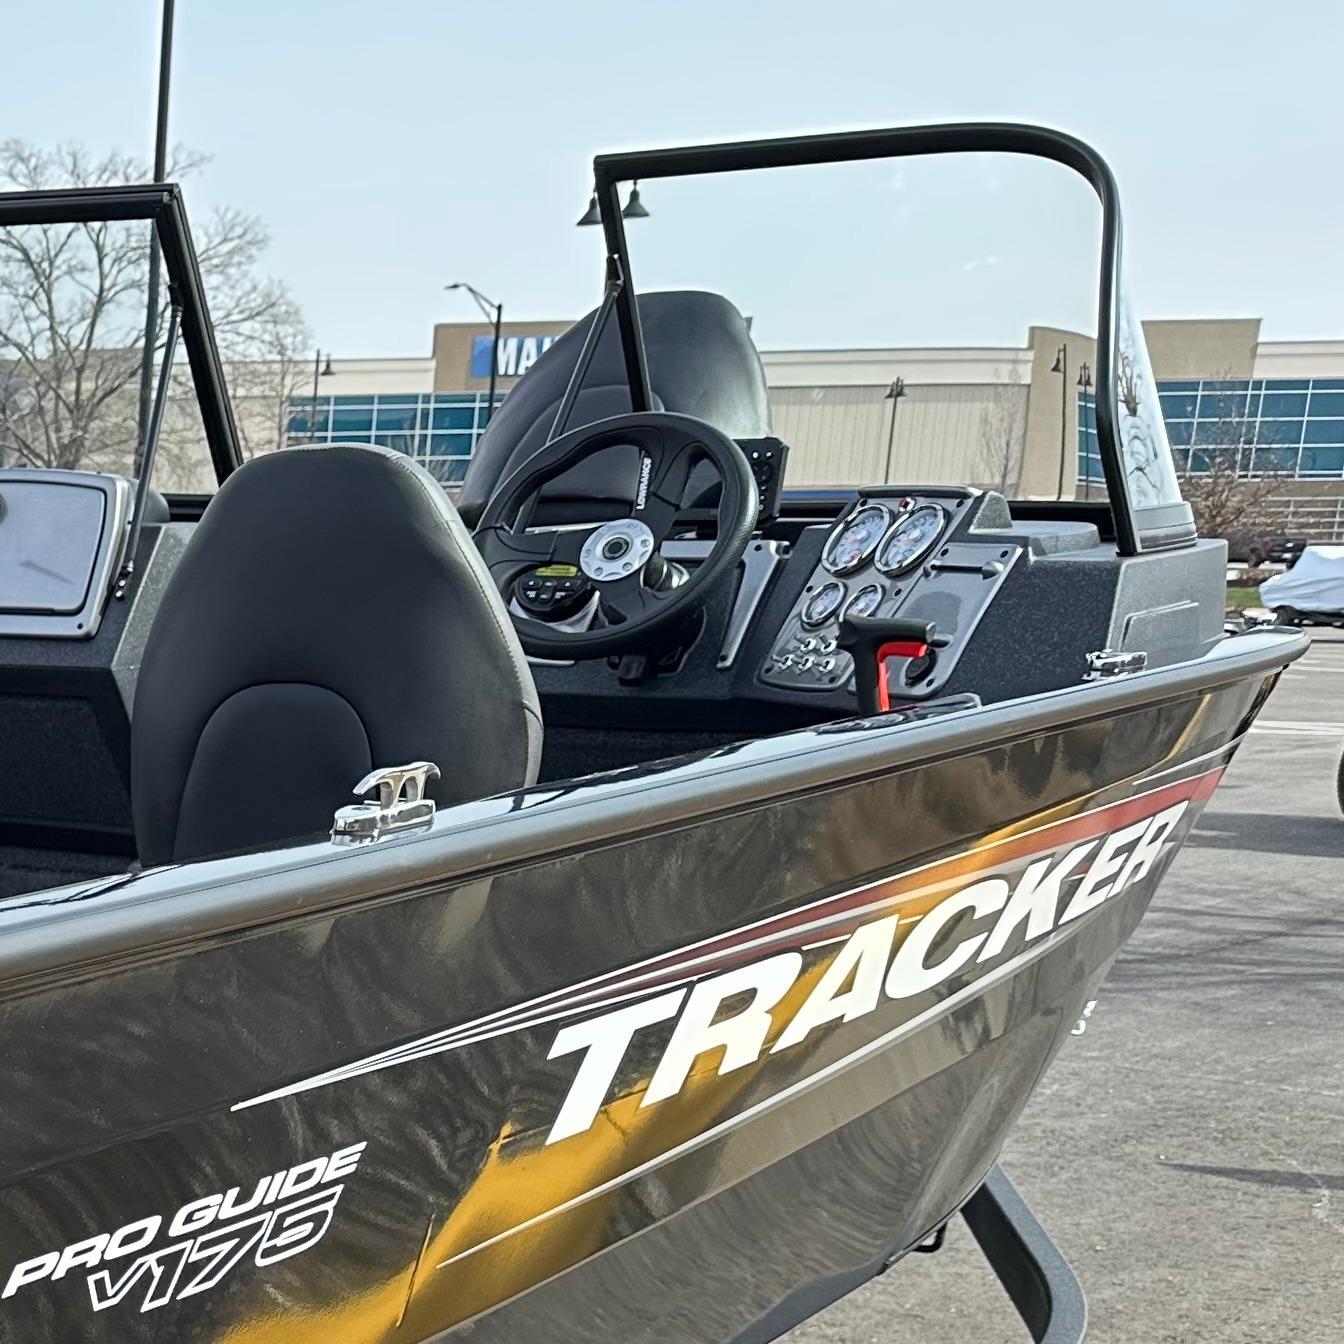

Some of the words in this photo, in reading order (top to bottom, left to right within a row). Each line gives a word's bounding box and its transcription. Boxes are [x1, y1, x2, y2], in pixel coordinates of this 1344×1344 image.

[545, 800, 1189, 1146] TRACKER
[1, 1214, 163, 1300] PRO
[168, 1140, 368, 1237] GUIDE
[86, 1183, 345, 1314] V175
